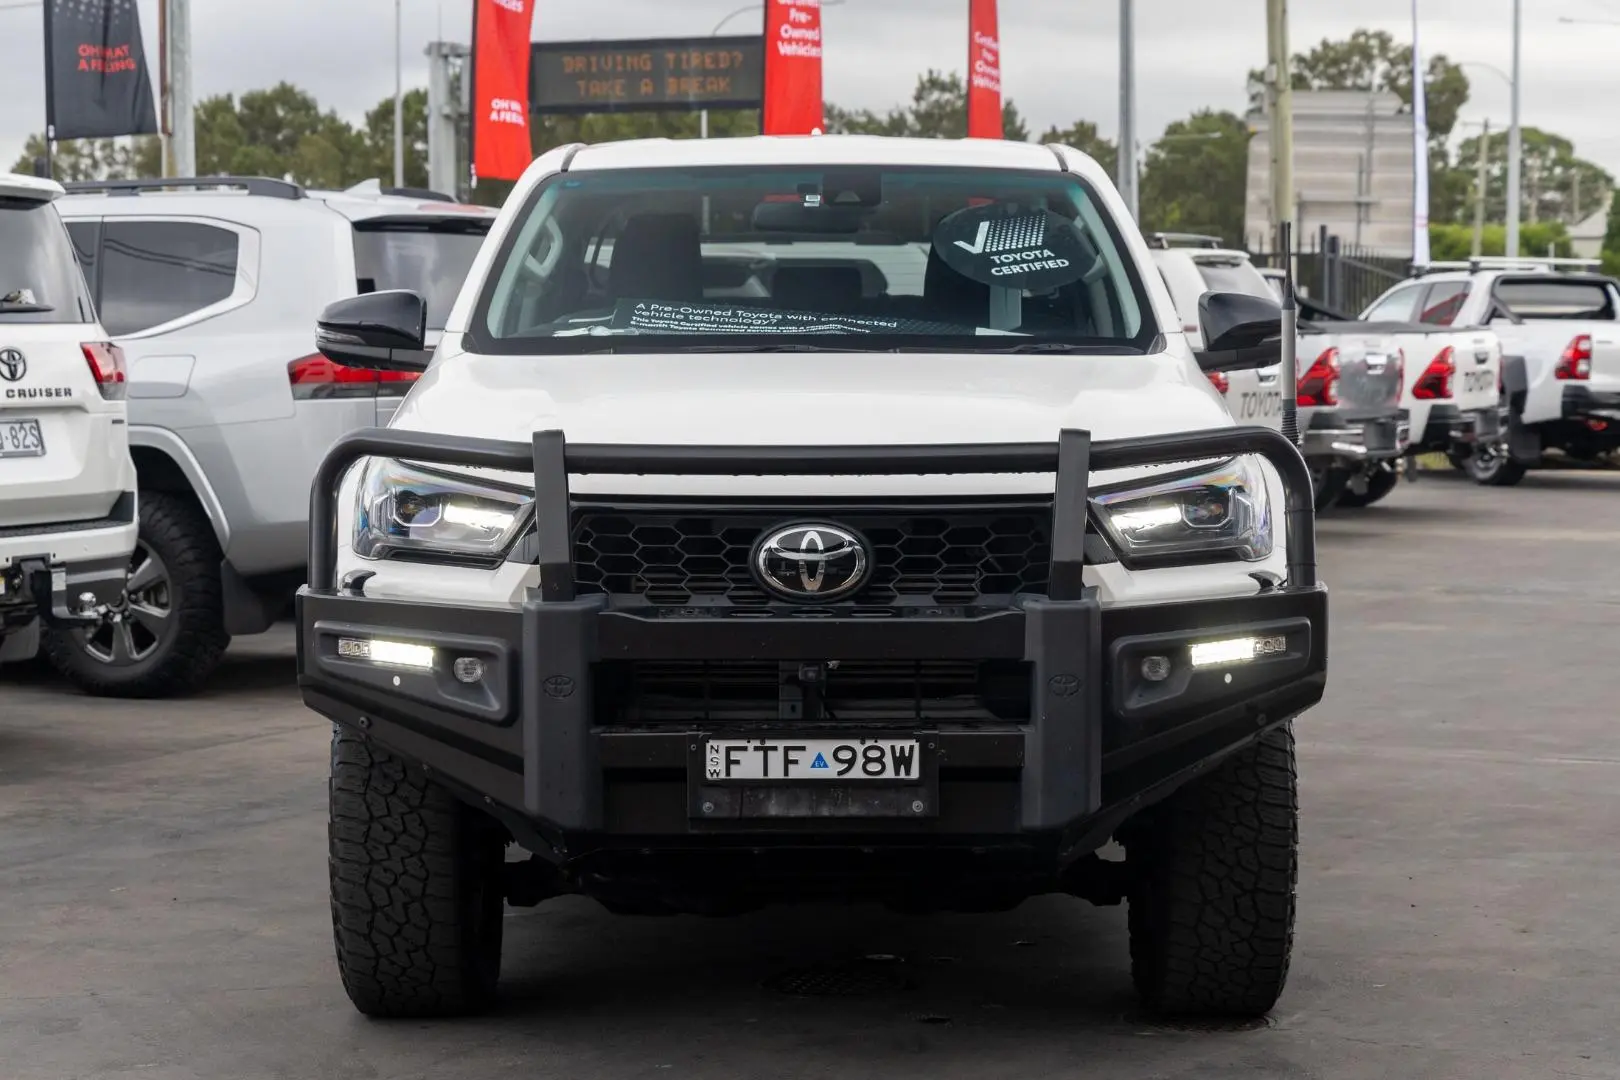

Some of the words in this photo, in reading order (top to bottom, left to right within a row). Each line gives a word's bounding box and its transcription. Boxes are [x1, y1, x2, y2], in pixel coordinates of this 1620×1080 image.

[789, 8, 812, 23] Pre-
[780, 24, 819, 40] Owned
[562, 54, 653, 73] DRIVING
[664, 51, 743, 70] TIRED?
[576, 79, 626, 97] TAKE
[640, 78, 653, 95] A
[667, 76, 731, 96] BREAK
[990, 249, 1055, 264] TOYOTA
[991, 259, 1070, 276] CERTIFIED
[634, 310, 684, 320] vehicle
[689, 314, 777, 325] technology?
[651, 304, 732, 316] Pre-Owned
[736, 310, 782, 319] Toyota
[821, 316, 897, 328] connected
[6, 387, 72, 398] CRUISER
[708, 744, 721, 777] NSW
[725, 745, 806, 777] FTF
[832, 745, 914, 776] 98W
